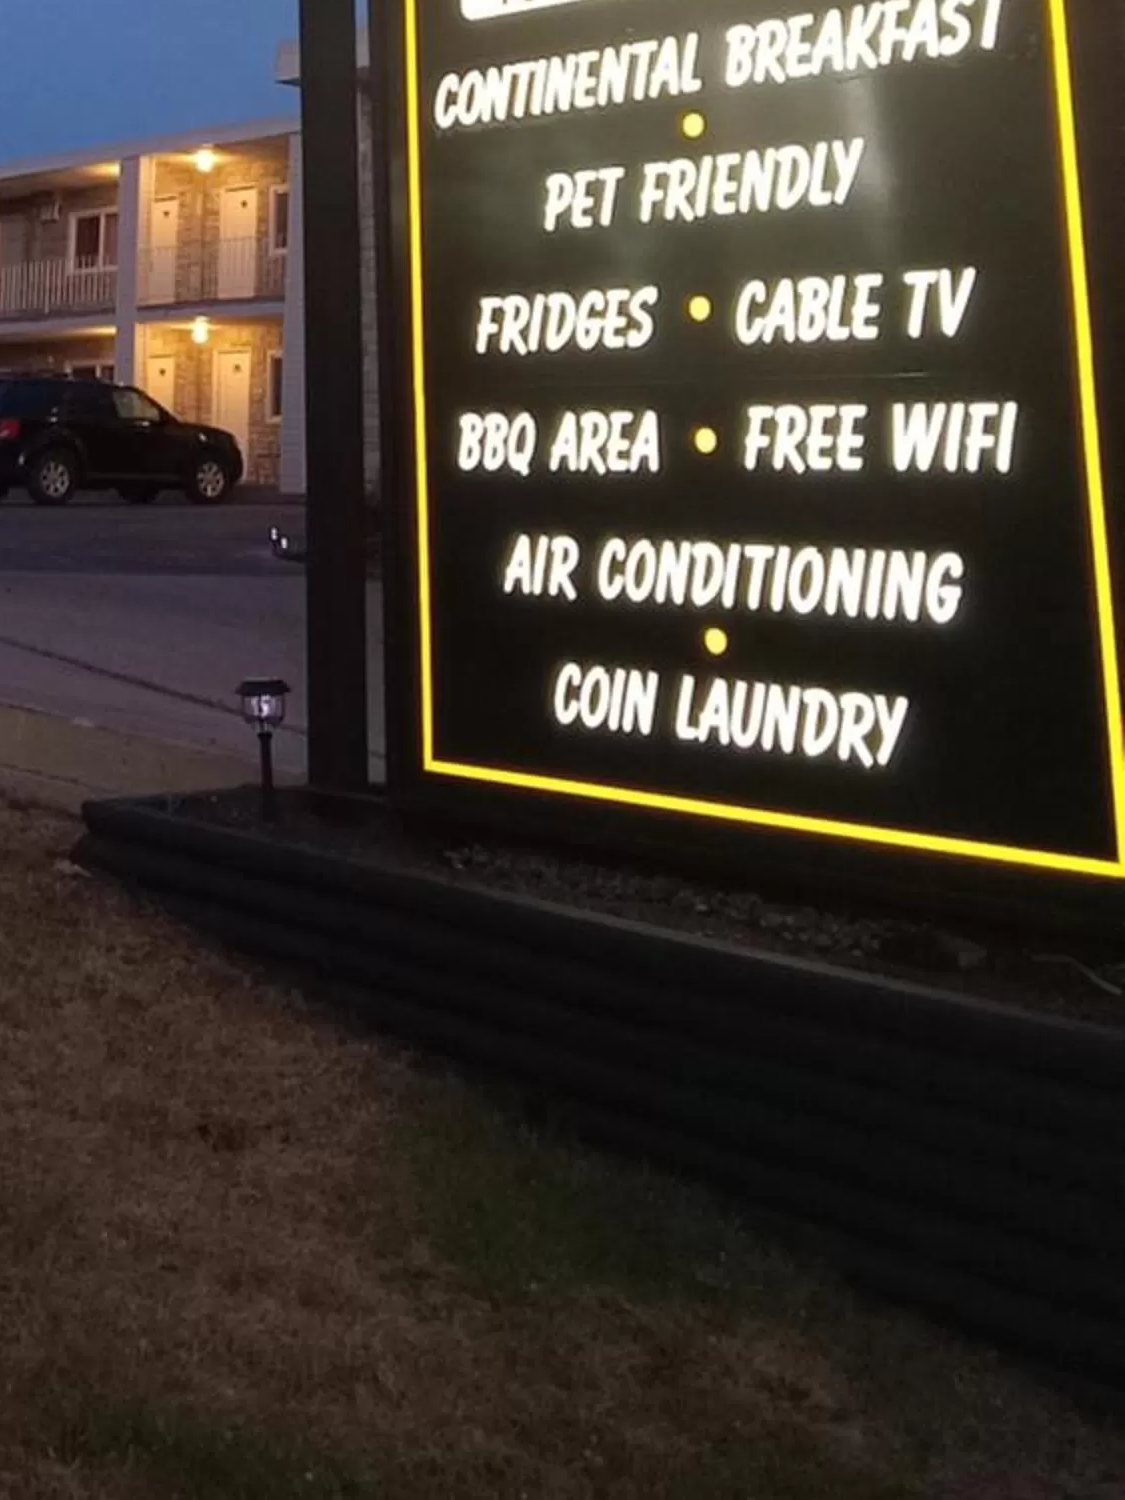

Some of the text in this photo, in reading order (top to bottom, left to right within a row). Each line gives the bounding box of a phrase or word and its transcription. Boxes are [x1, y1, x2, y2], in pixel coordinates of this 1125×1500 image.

[435, 31, 702, 130] CONTINENTAL
[543, 137, 864, 232] PET FRIENDLY
[475, 267, 976, 355] FRIDGES CABLE TV
[457, 401, 1018, 476] BBQ AREA FREE WIFI
[503, 534, 964, 623] AIR CONDITIONING
[554, 662, 908, 768] COIN LAUNDRY
